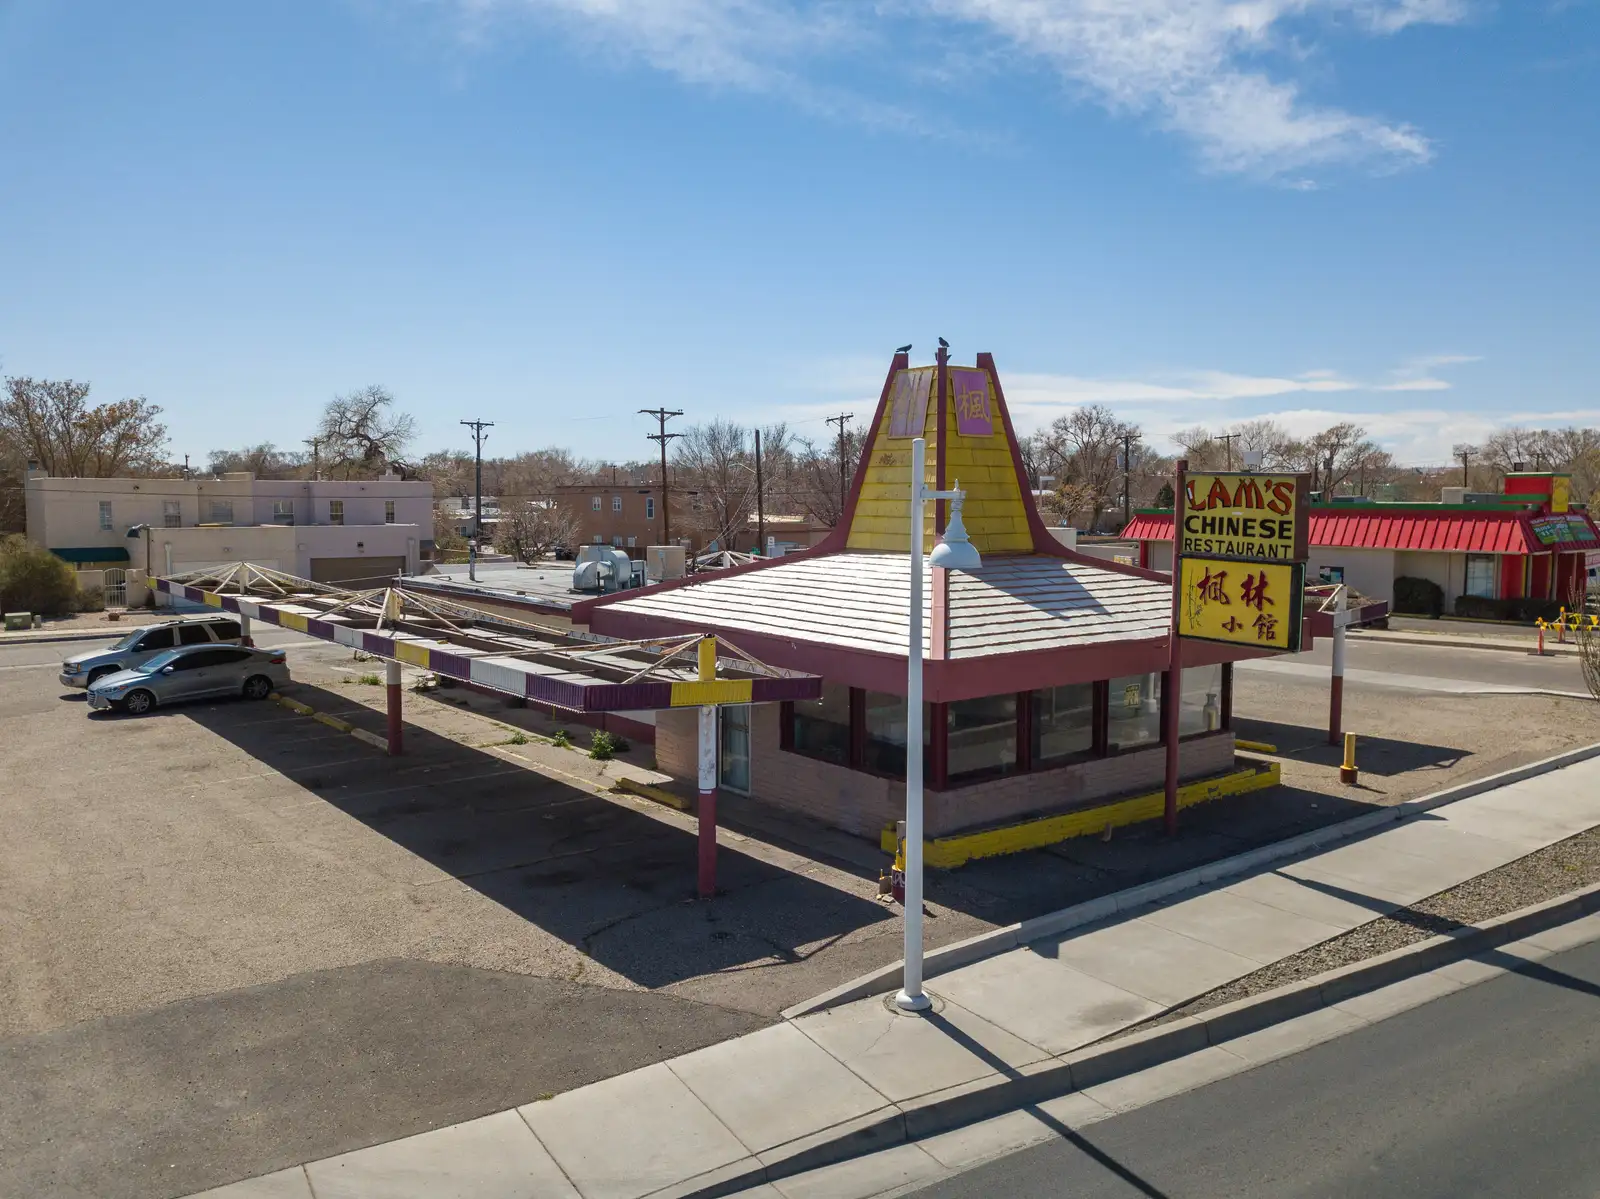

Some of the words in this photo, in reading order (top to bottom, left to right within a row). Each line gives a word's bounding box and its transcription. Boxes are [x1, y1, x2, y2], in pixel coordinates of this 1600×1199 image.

[958, 384, 990, 423] 楓
[1186, 477, 1295, 516] LAM'S
[1185, 515, 1293, 540] CHINESE
[1185, 538, 1292, 559] RESTAURANT
